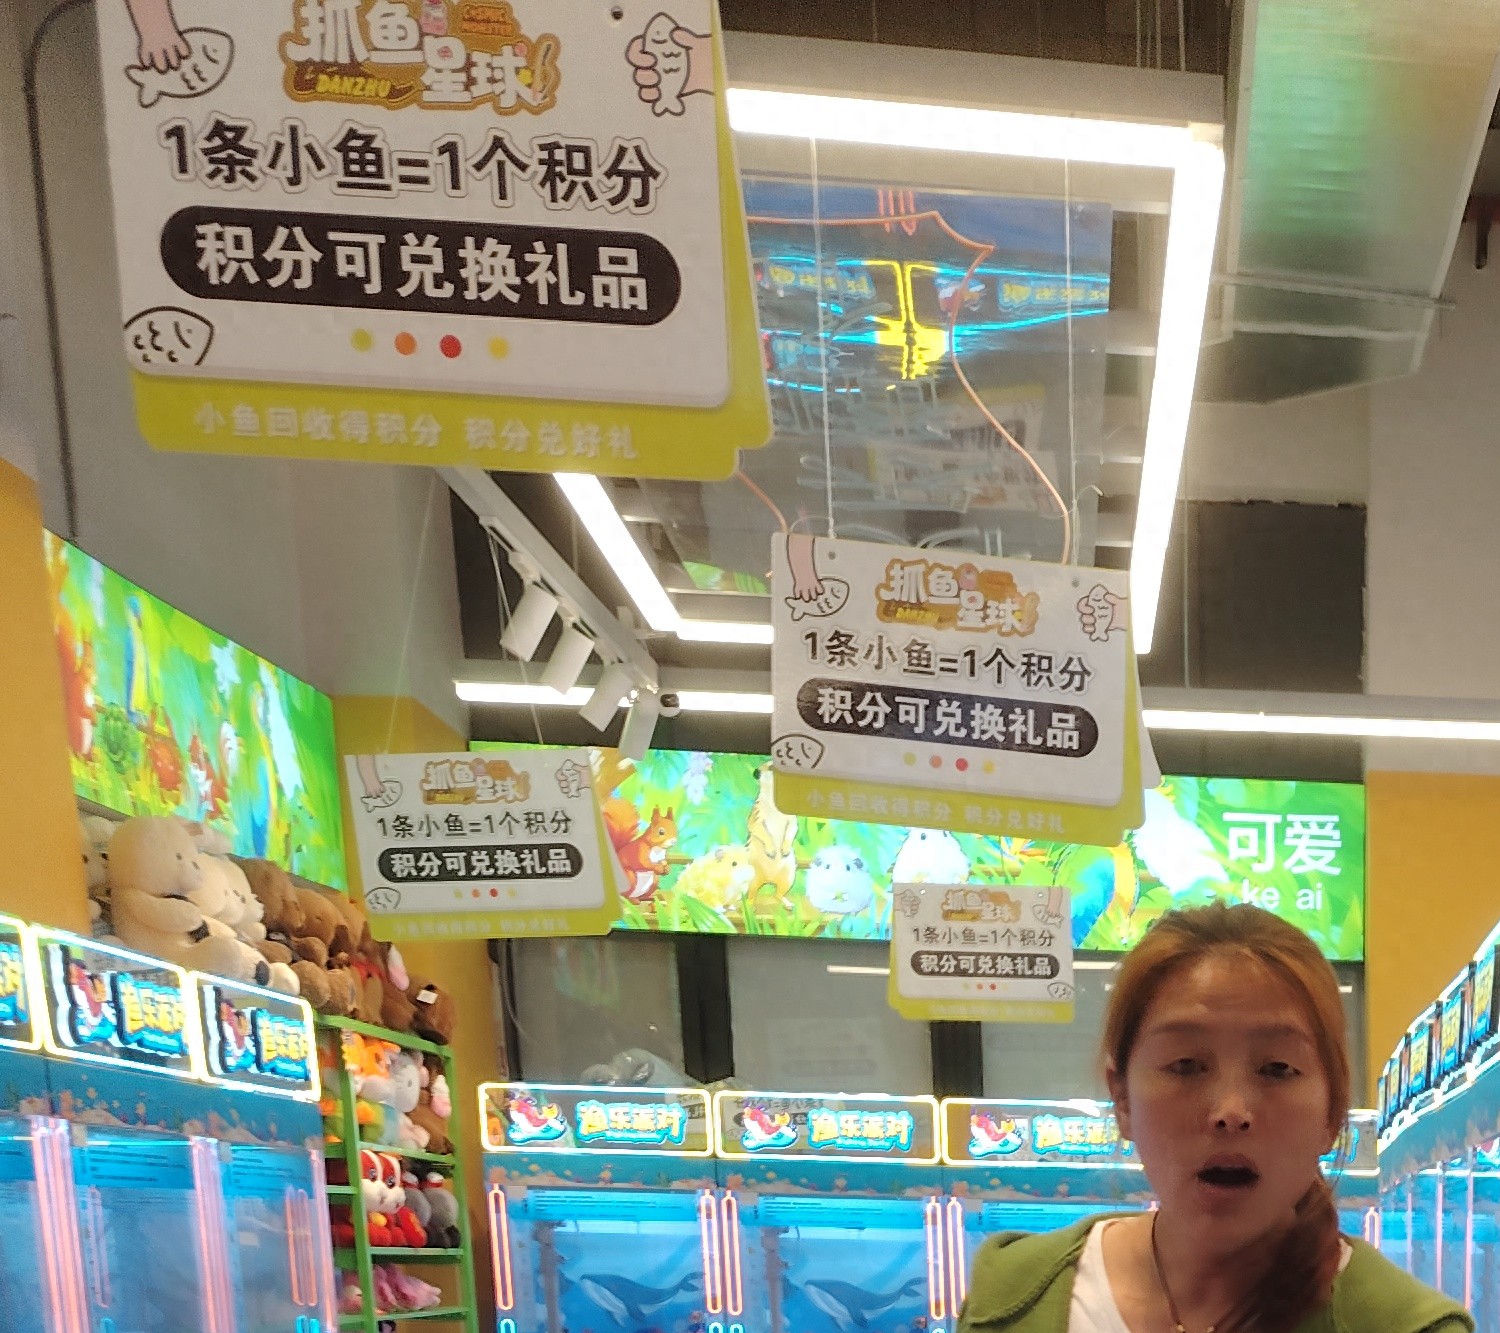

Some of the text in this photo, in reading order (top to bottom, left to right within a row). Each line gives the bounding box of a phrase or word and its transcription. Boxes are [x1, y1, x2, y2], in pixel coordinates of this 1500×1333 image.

[163, 117, 662, 209] 1条小鱼=1个积分
[195, 220, 649, 312] 积分可兑换礼品
[803, 629, 1092, 693] 1条小鱼=1个积分
[816, 687, 1081, 750] 积分可兑换礼品
[376, 809, 573, 839] 1条小鱼=1个积分
[1222, 811, 1342, 875] 可爱
[390, 848, 572, 878] 积分可兑换礼品
[1242, 878, 1323, 910] ke ai
[912, 926, 1055, 948] 1条小鱼=1个积分
[919, 954, 1052, 976] 积分可兑换礼品
[578, 1101, 687, 1142] 渔乐派对
[810, 1110, 914, 1150] 渔乐派对
